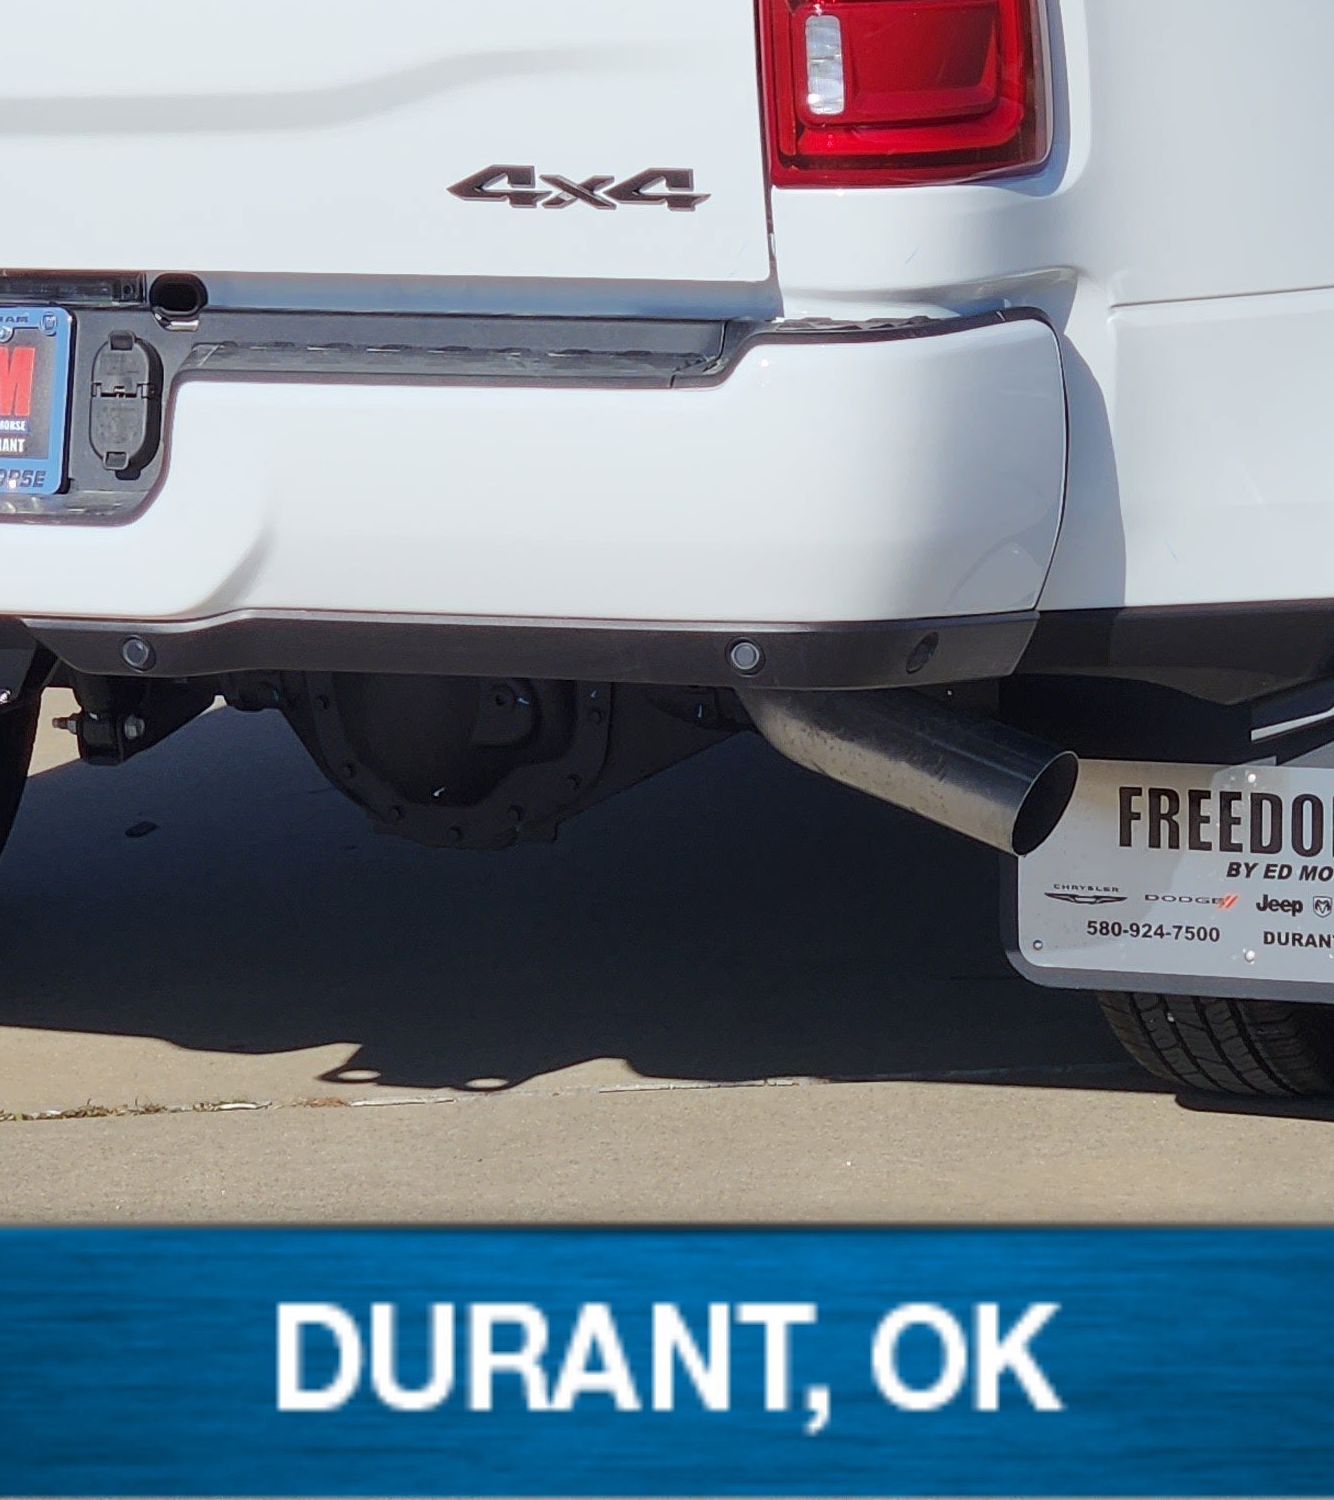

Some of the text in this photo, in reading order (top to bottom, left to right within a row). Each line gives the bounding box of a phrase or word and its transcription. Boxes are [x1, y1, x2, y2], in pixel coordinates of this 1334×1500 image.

[1226, 861, 1259, 879] BY
[1262, 863, 1293, 881] ED
[1053, 883, 1120, 893] CHRYSLER
[1143, 894, 1225, 905] DODGE
[1255, 894, 1304, 918] Jeep
[1086, 920, 1221, 943] 580-924-7500
